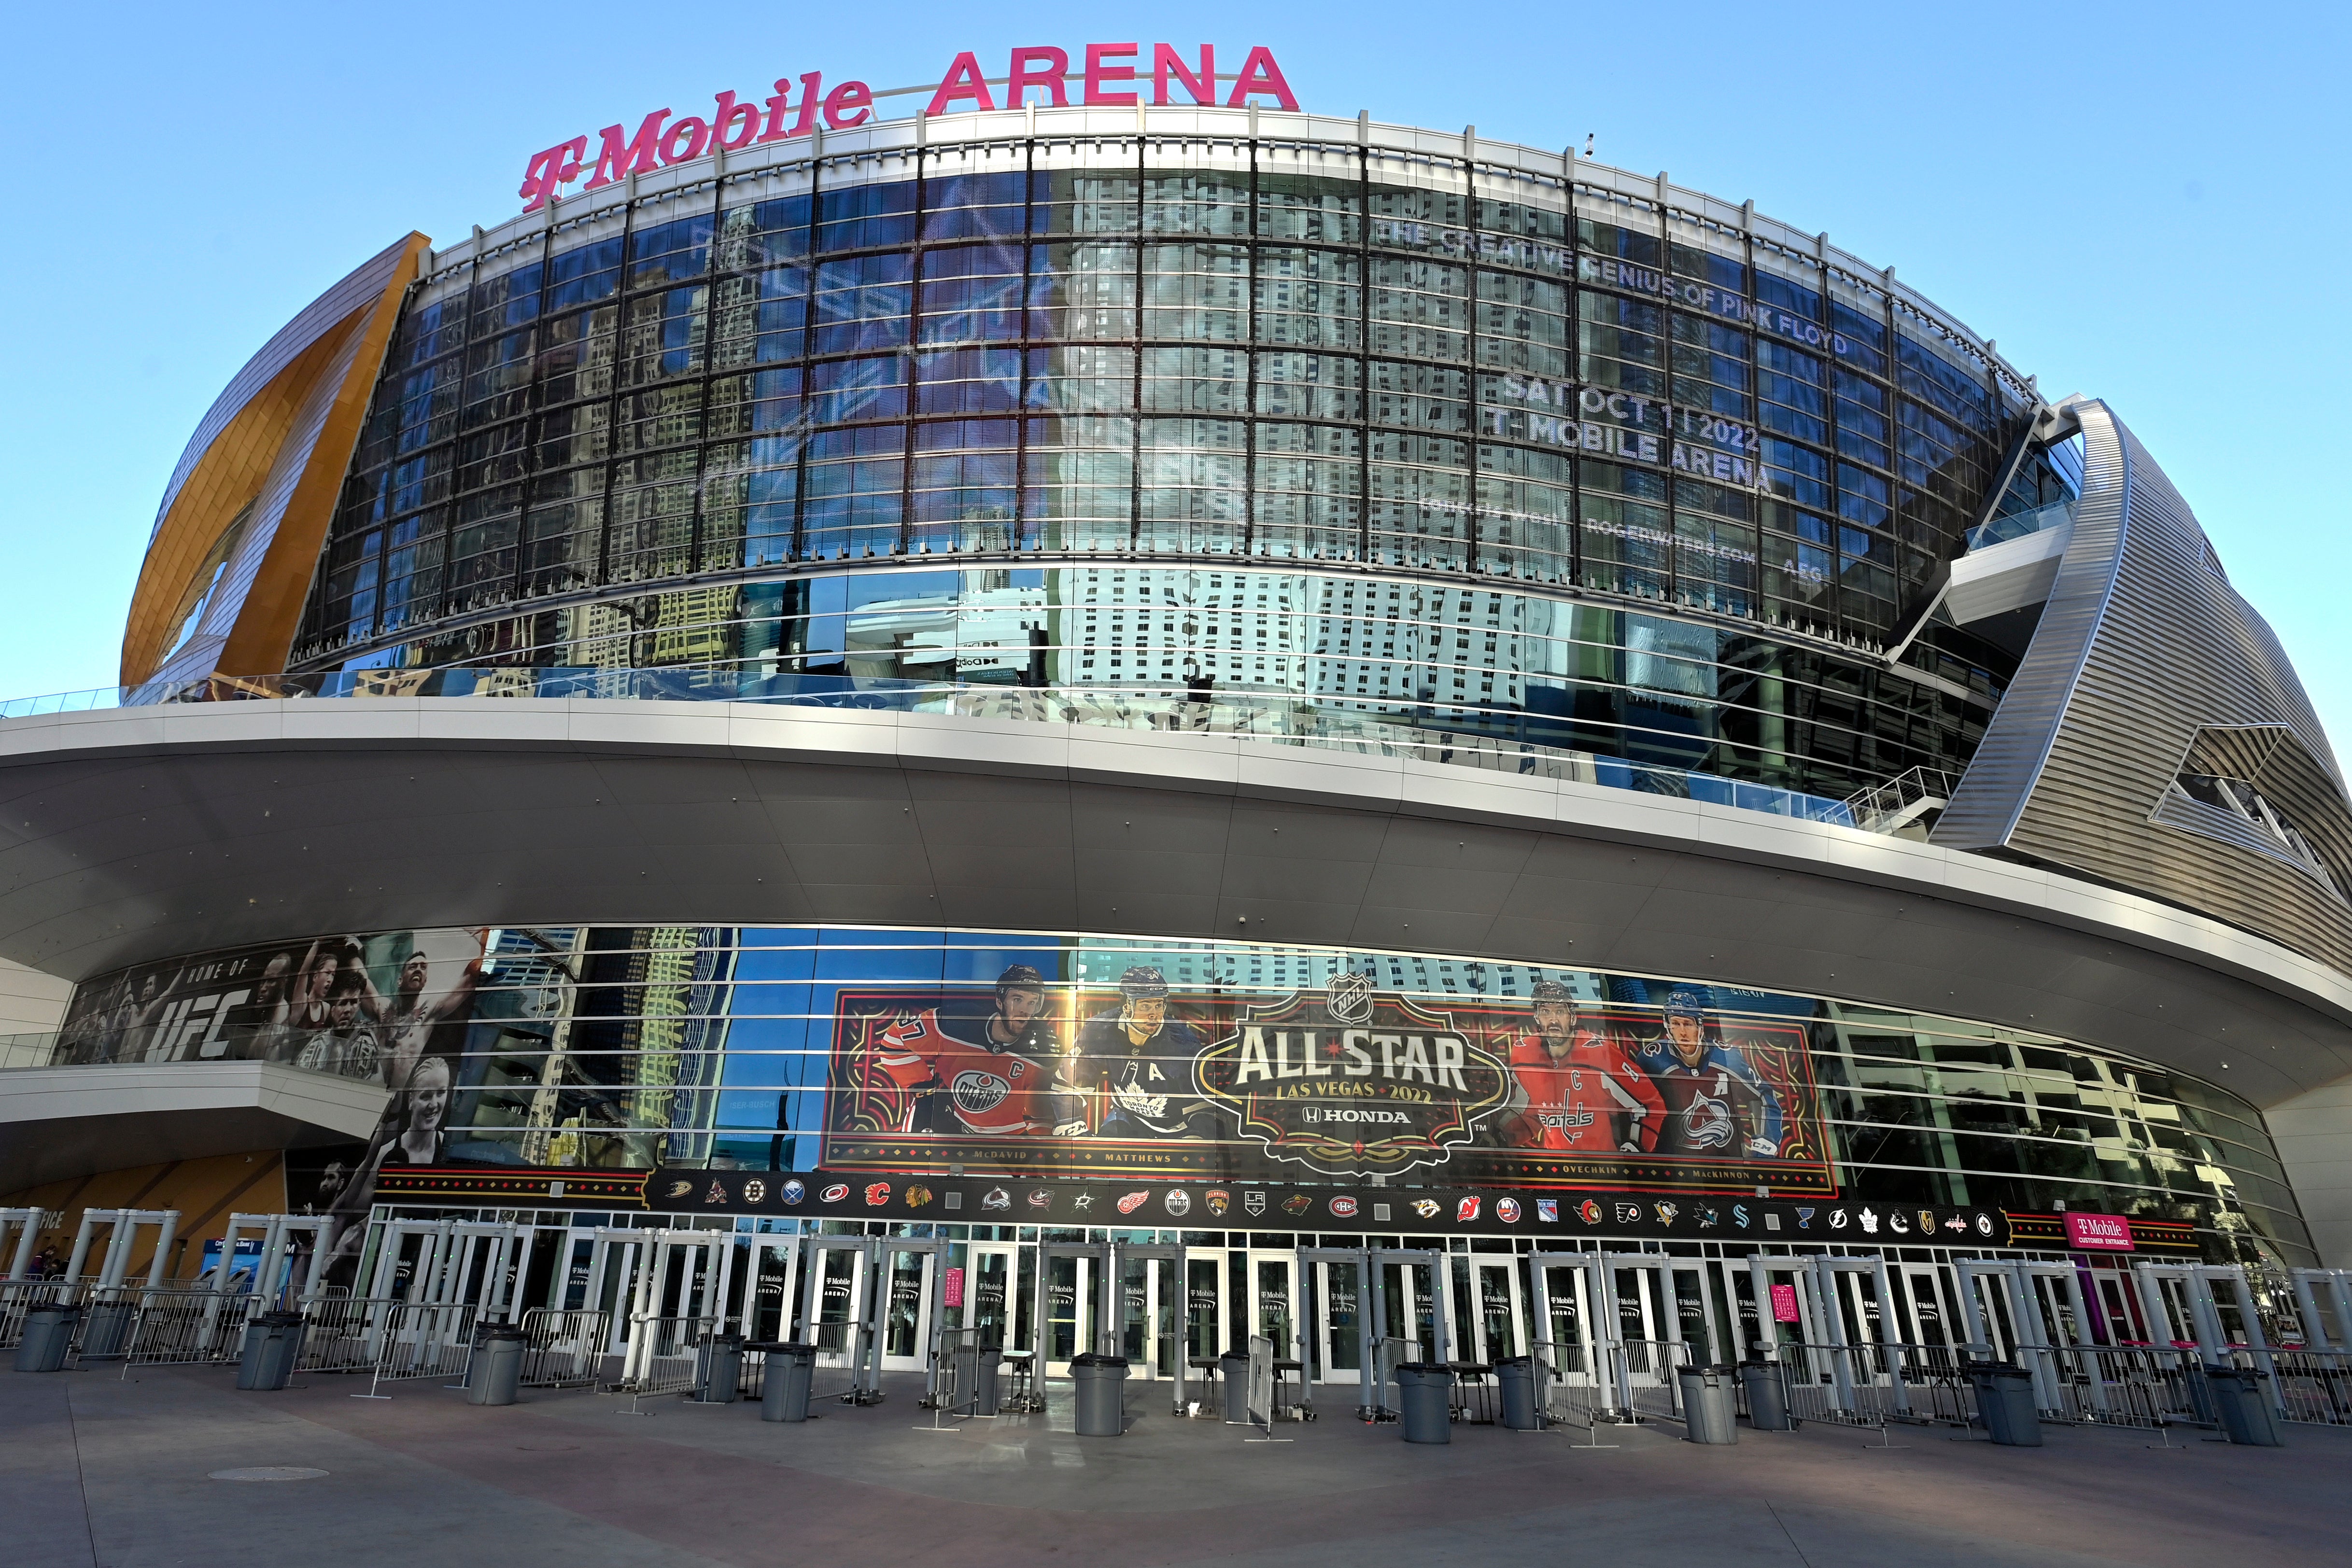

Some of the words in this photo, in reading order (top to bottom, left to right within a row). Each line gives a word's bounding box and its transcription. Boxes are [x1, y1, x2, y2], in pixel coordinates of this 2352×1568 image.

[924, 42, 1301, 117] ARENA
[1374, 219, 1431, 245] THE
[1440, 229, 1575, 270] CREATIVE
[1582, 255, 1676, 297] GENIUS
[1685, 284, 1715, 307] OF
[1722, 294, 1773, 329] PINK
[1779, 314, 1848, 355] FLOYD
[1504, 372, 1571, 406] SAT
[1579, 388, 1649, 423] OCT
[1661, 404, 1673, 429] 1
[1699, 414, 1759, 452] 2022
[1486, 406, 1659, 462] T-MOBILE
[1672, 442, 1772, 493] ARENA
[1783, 559, 1822, 582] AEG
[186, 964, 223, 983] HOME
[229, 959, 248, 976] OF
[1338, 986, 1364, 1013] NHL
[144, 989, 251, 1063] UFC
[1008, 1061, 1024, 1078] C
[1234, 1026, 1332, 1086] ALL
[1342, 1029, 1469, 1093] STAR
[1149, 1062, 1166, 1081] A
[1570, 1070, 1582, 1090] C
[958, 1081, 1003, 1110] OILERS
[1276, 1083, 1310, 1100] LAS
[1315, 1081, 1375, 1097] VEGAS
[1389, 1084, 1433, 1104] 2022
[1123, 1100, 1159, 1111] TORONTO
[1324, 1109, 1411, 1124] HONDA
[1105, 1154, 1170, 1162] MATTHEWS
[1563, 1165, 1618, 1174] OVECHKIN
[1169, 1199, 1187, 1214] OILERS
[1247, 1194, 1263, 1202] LA
[39, 1211, 65, 1229] FICE
[1542, 1207, 1556, 1219] RANGERS
